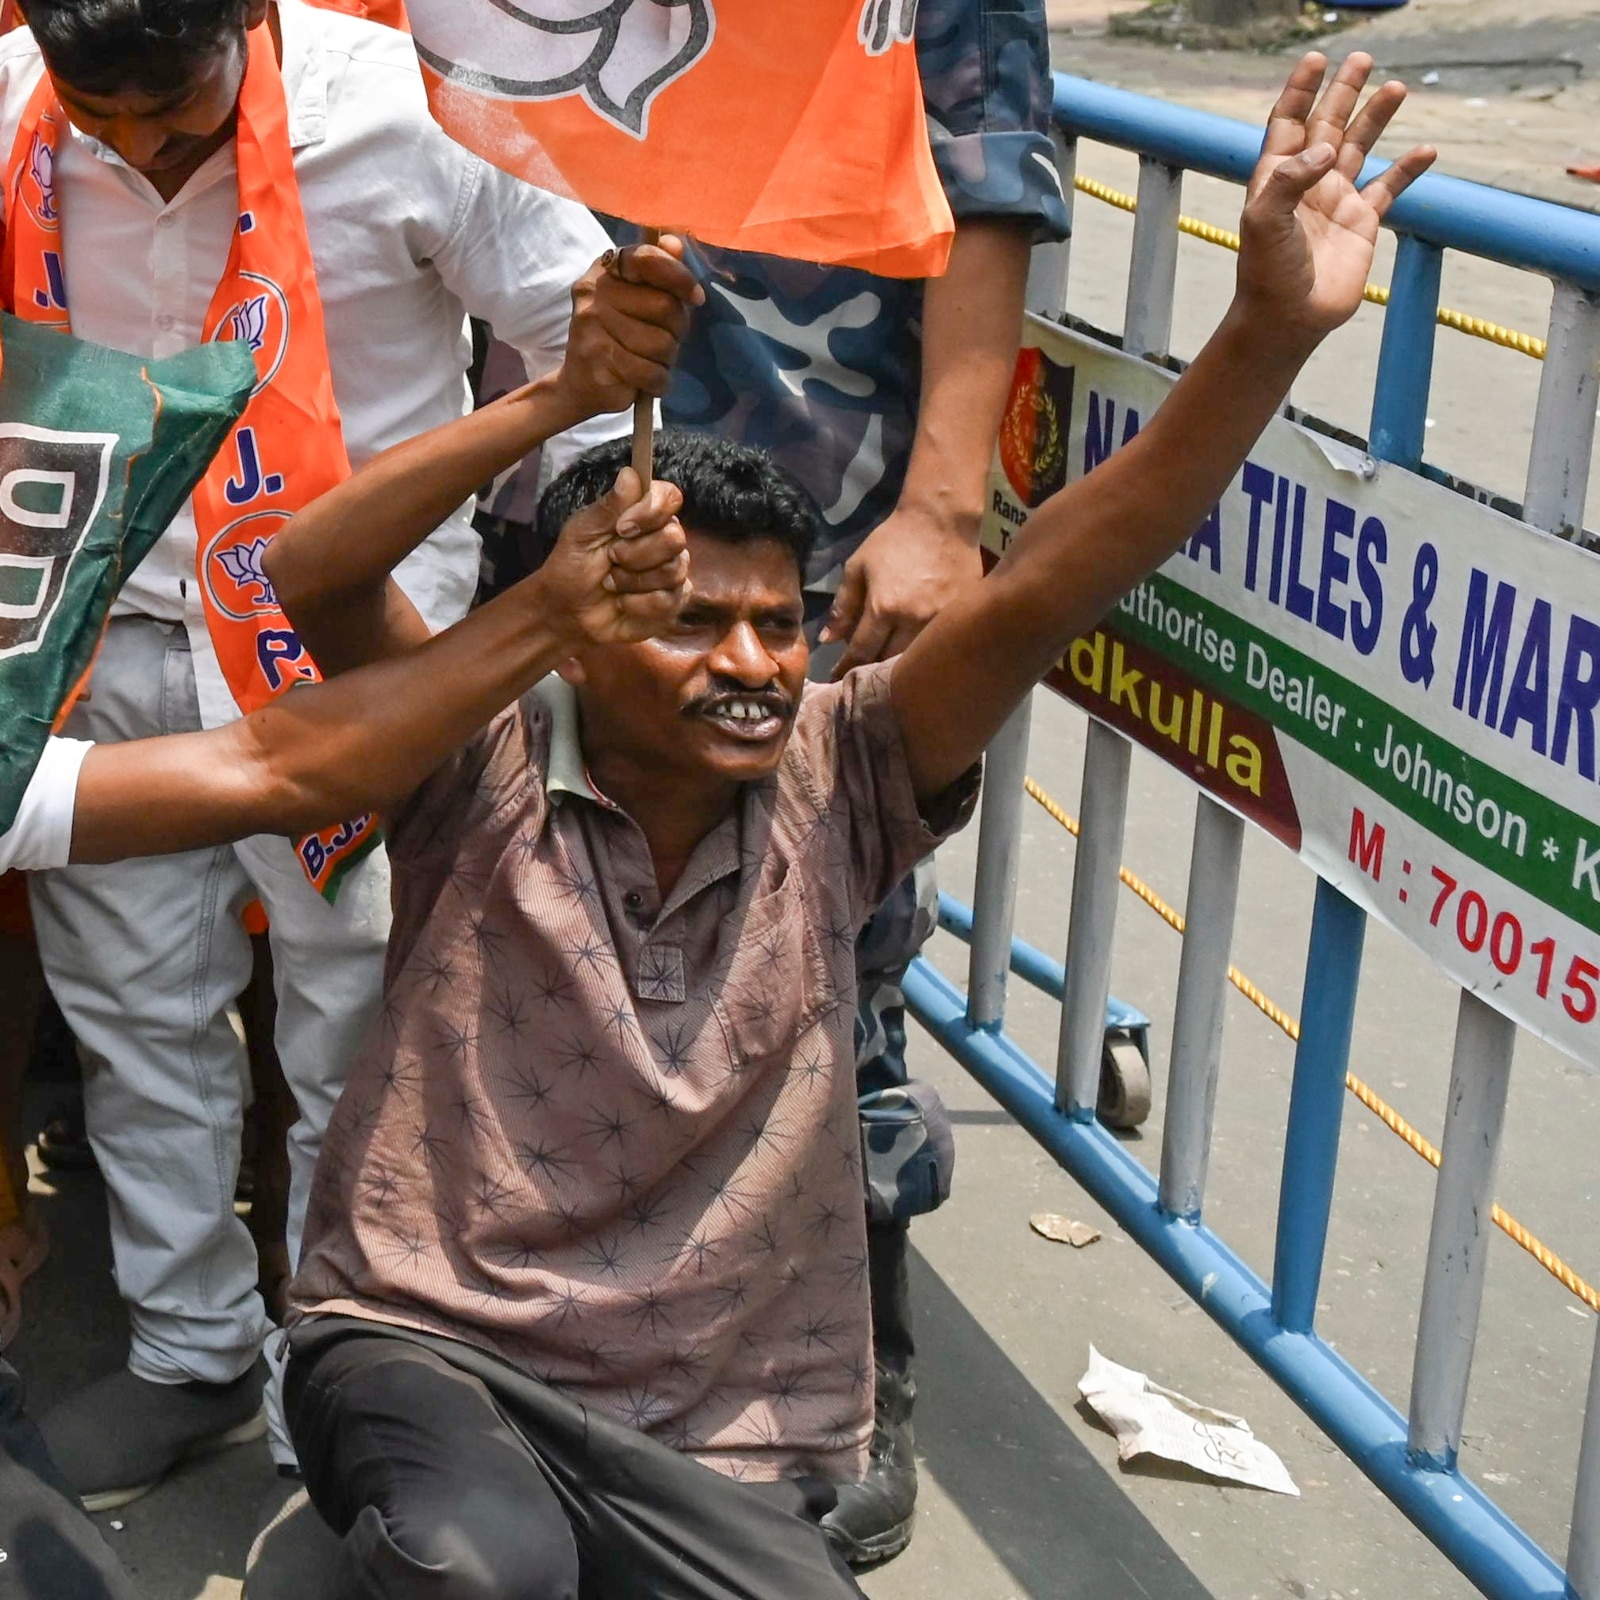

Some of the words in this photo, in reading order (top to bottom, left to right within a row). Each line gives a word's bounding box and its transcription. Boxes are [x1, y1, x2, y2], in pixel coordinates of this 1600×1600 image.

[1056, 631, 1262, 798] dkulla
[1116, 576, 1237, 674] uthorise
[1245, 641, 1346, 738] Dealer
[1373, 724, 1528, 858] Johnson
[1241, 460, 1388, 656] TILES
[1400, 542, 1439, 692] &
[1452, 567, 1600, 787] MAR
[1348, 806, 1386, 883] M
